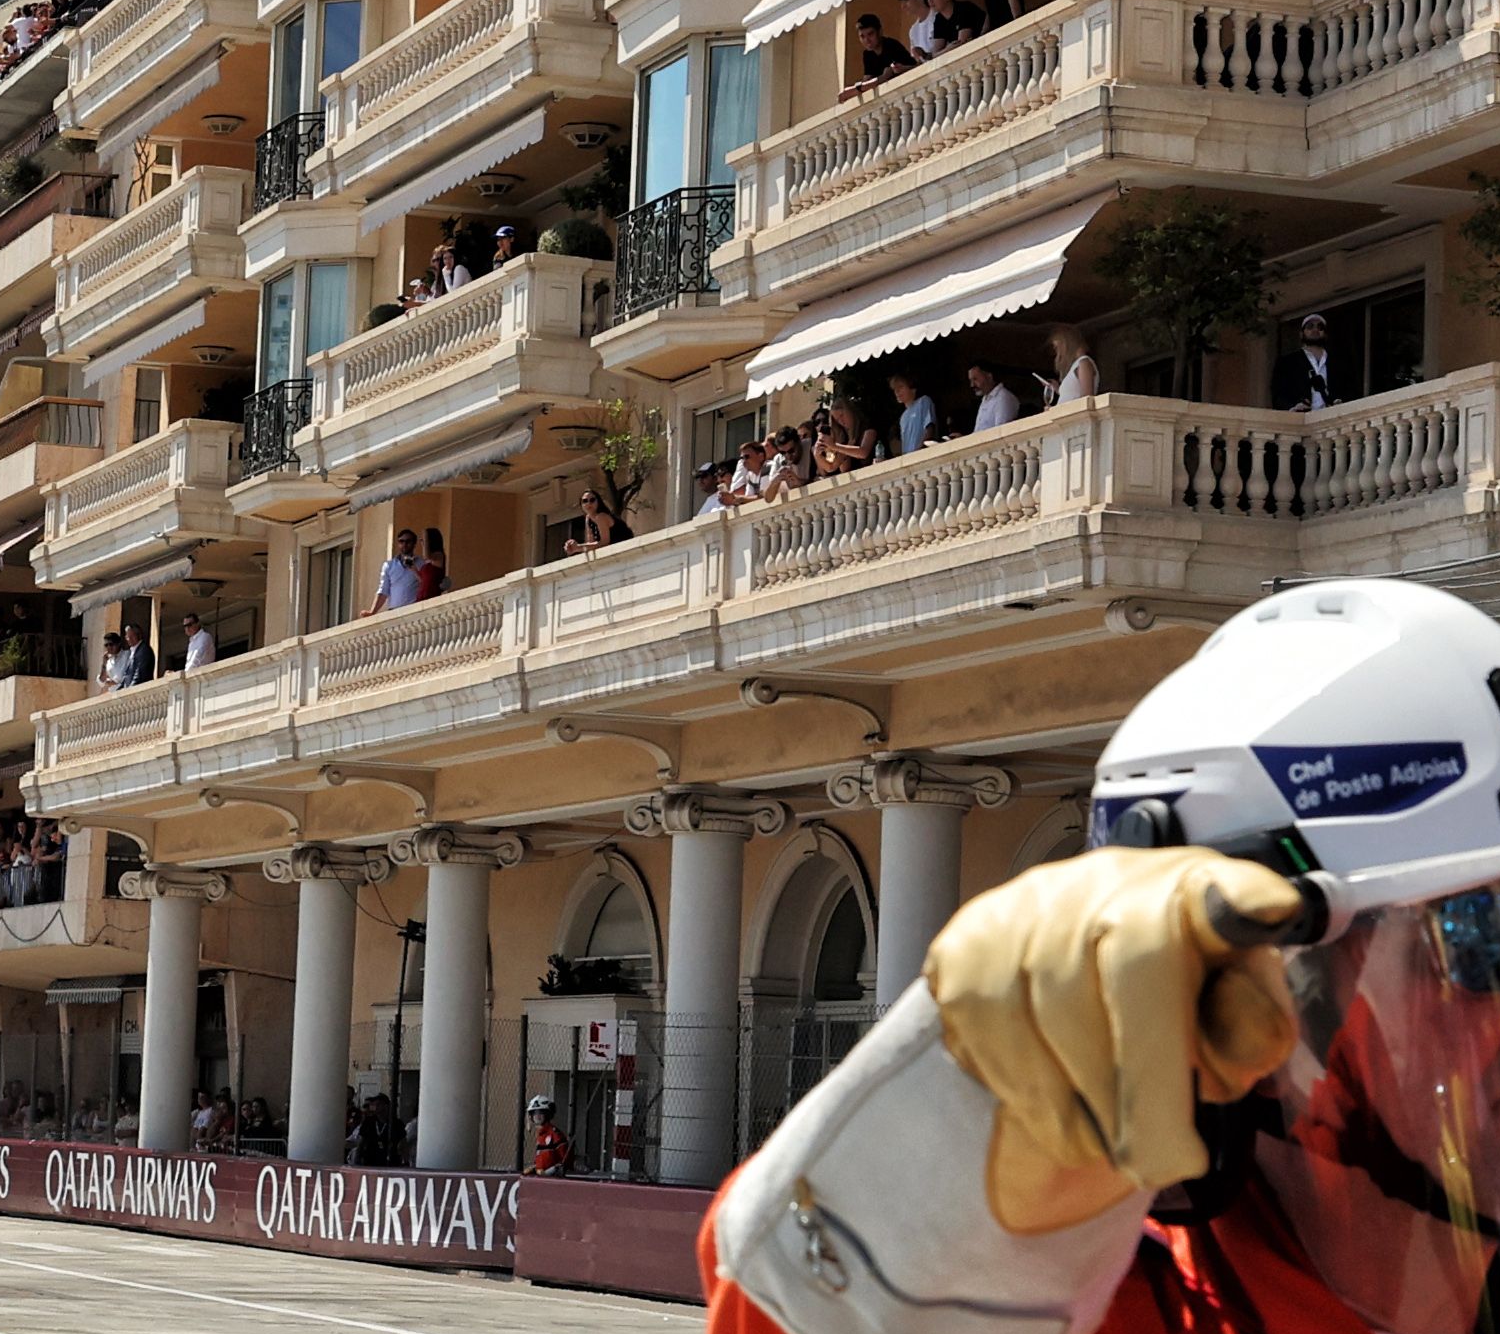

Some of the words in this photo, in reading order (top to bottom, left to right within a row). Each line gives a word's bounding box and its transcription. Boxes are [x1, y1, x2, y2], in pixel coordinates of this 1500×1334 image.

[1288, 753, 1334, 784] Chef
[1295, 789, 1321, 810] de
[1325, 772, 1384, 801] Poste
[1390, 756, 1461, 786] Adjoint
[46, 1149, 115, 1212] QATAR
[121, 1156, 216, 1224] AIRWAYS
[256, 1165, 344, 1240] QATAR
